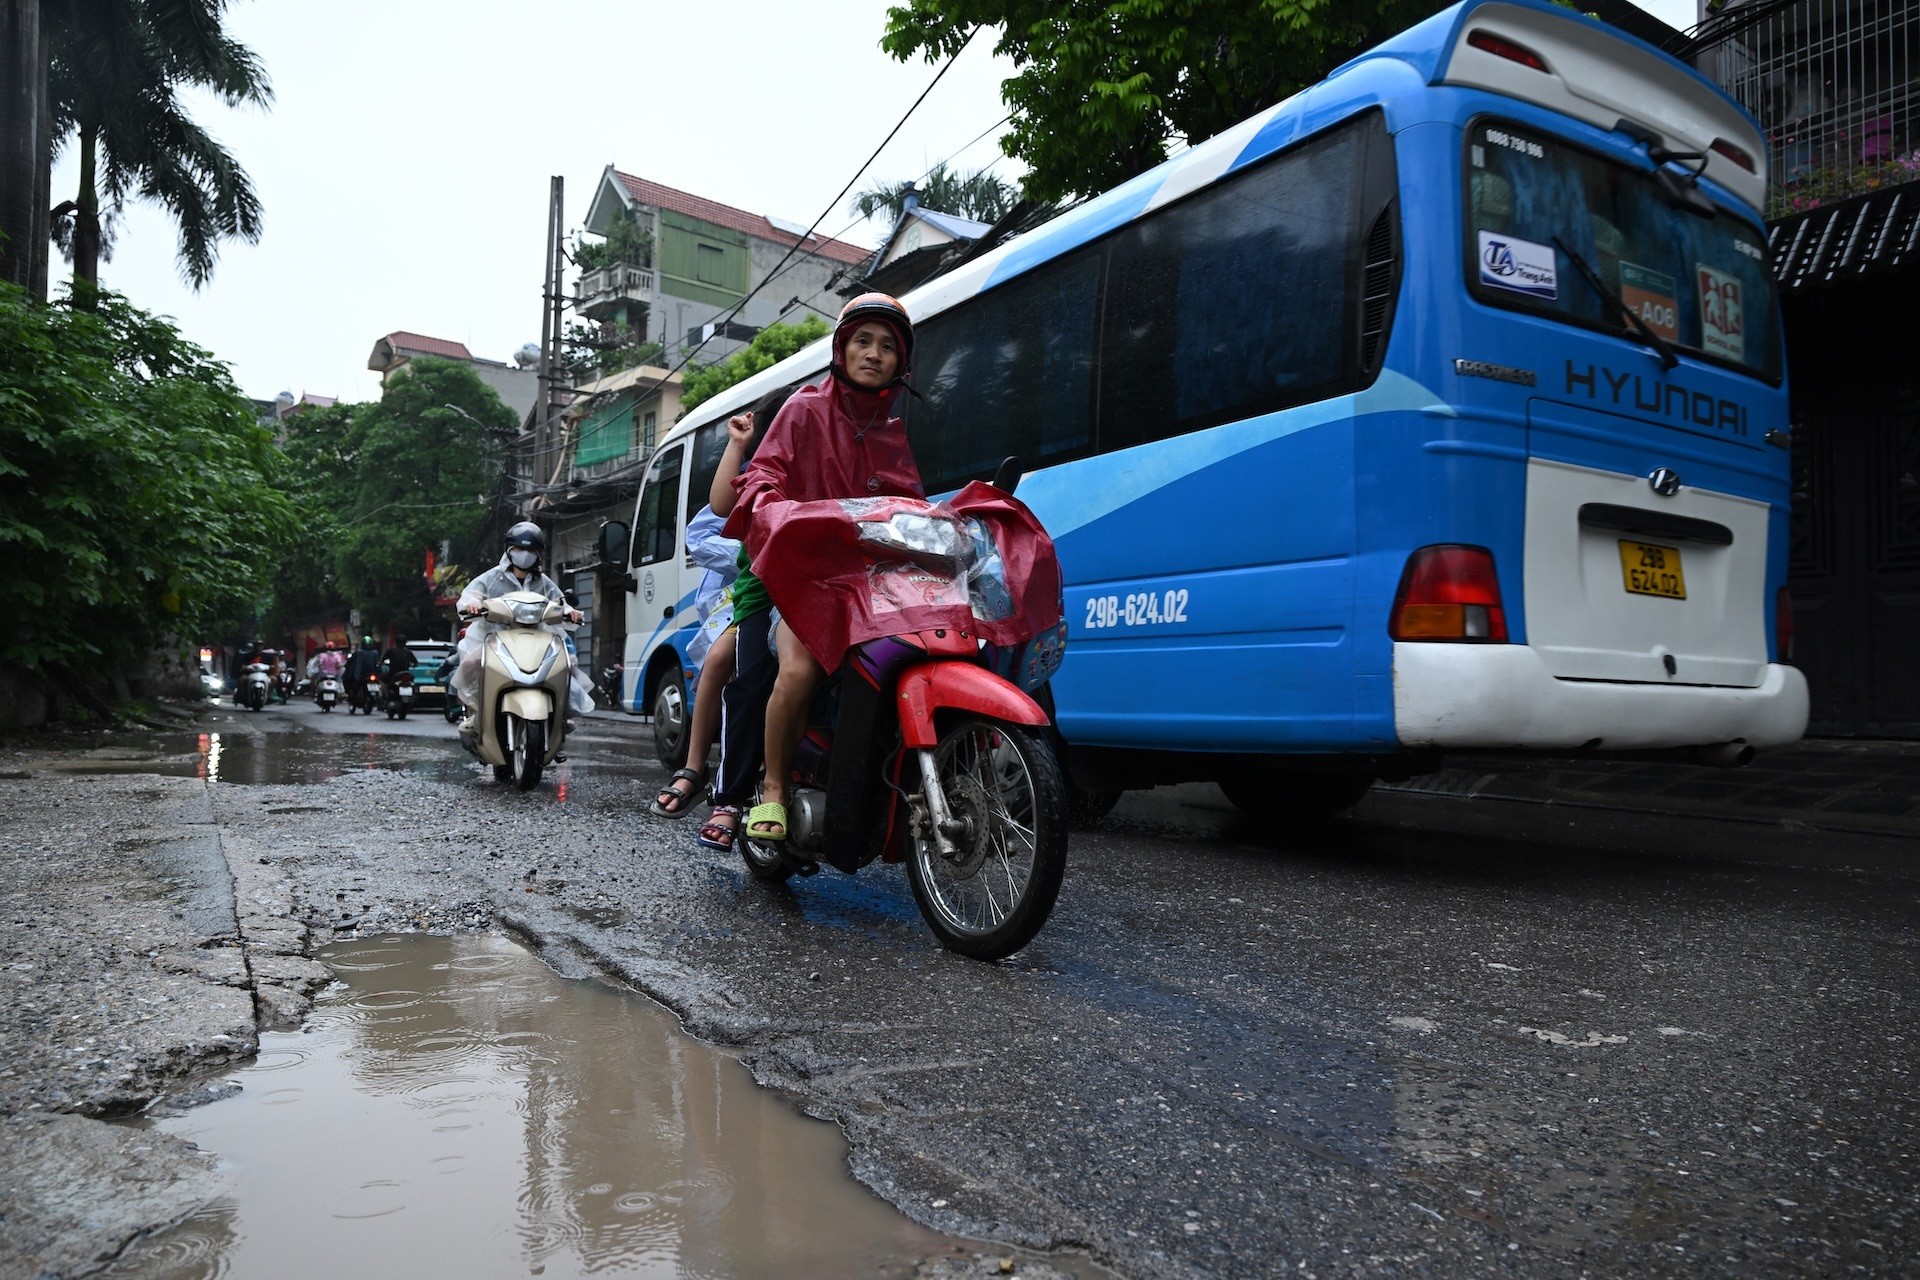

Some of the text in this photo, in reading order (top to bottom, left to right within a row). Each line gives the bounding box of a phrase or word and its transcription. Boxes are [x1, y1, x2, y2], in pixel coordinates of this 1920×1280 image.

[1565, 359, 1748, 437] HYUNDAI
[1638, 546, 1664, 569] 29B
[1631, 569, 1680, 595] 624.02
[1085, 588, 1189, 630] 29B-624.02
